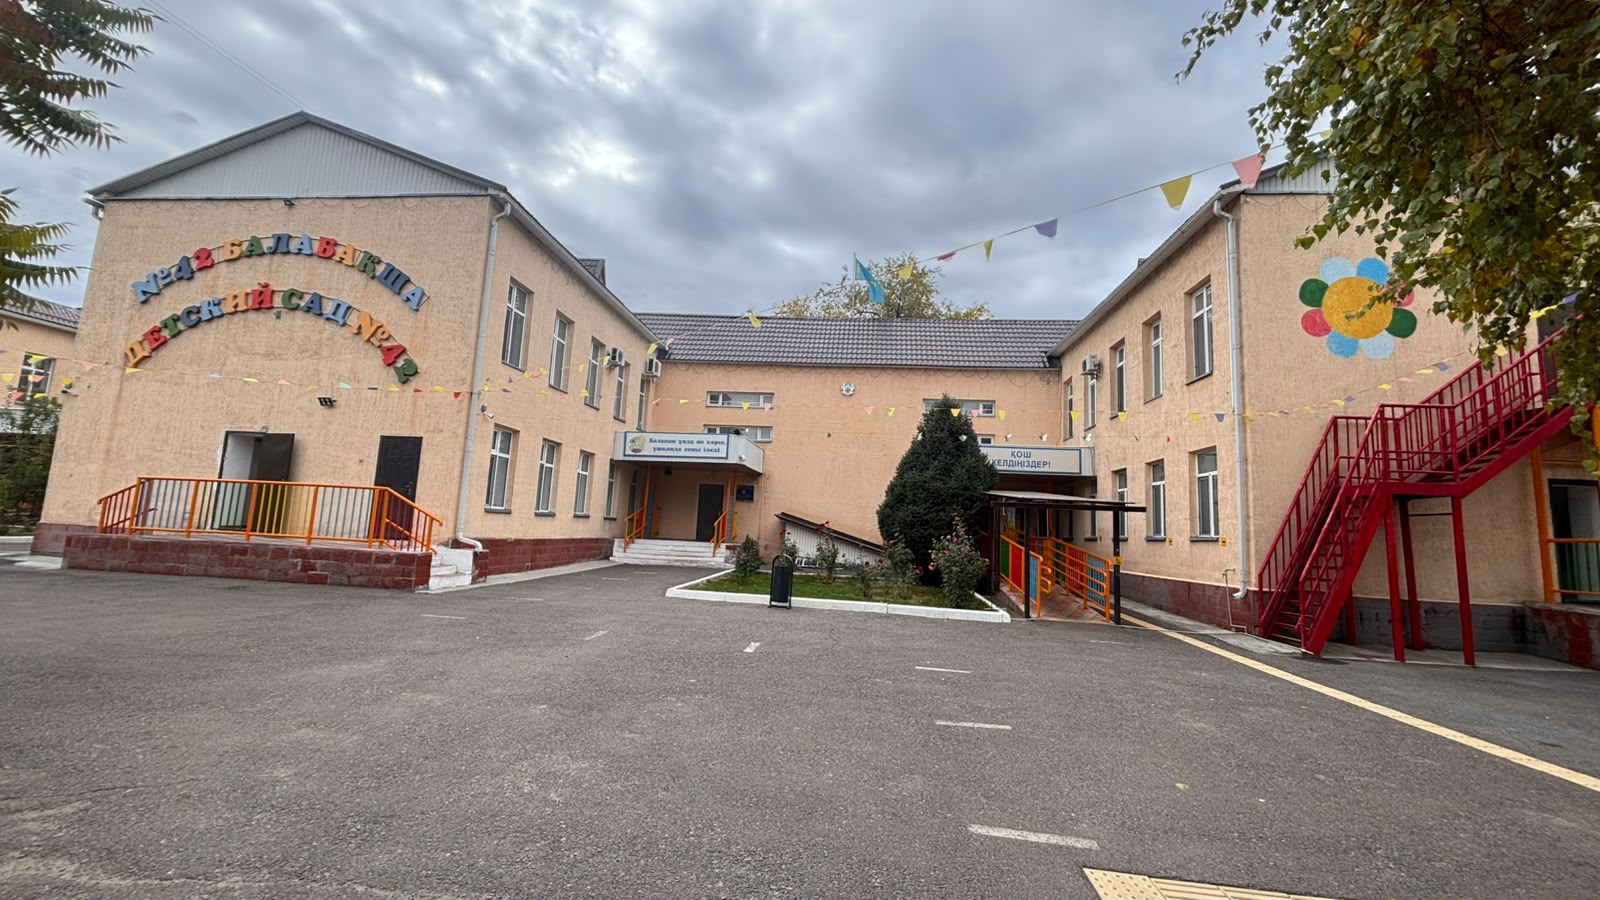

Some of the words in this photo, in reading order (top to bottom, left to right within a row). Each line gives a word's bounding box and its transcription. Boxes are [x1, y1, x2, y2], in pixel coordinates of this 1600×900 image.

[131, 247, 215, 304] №42
[223, 233, 426, 311] БАЛАБАҚША
[124, 281, 274, 367] ДЕТСКИЙ
[281, 287, 352, 326] САД
[350, 311, 418, 384] №42
[1010, 450, 1032, 459] ҚОШ
